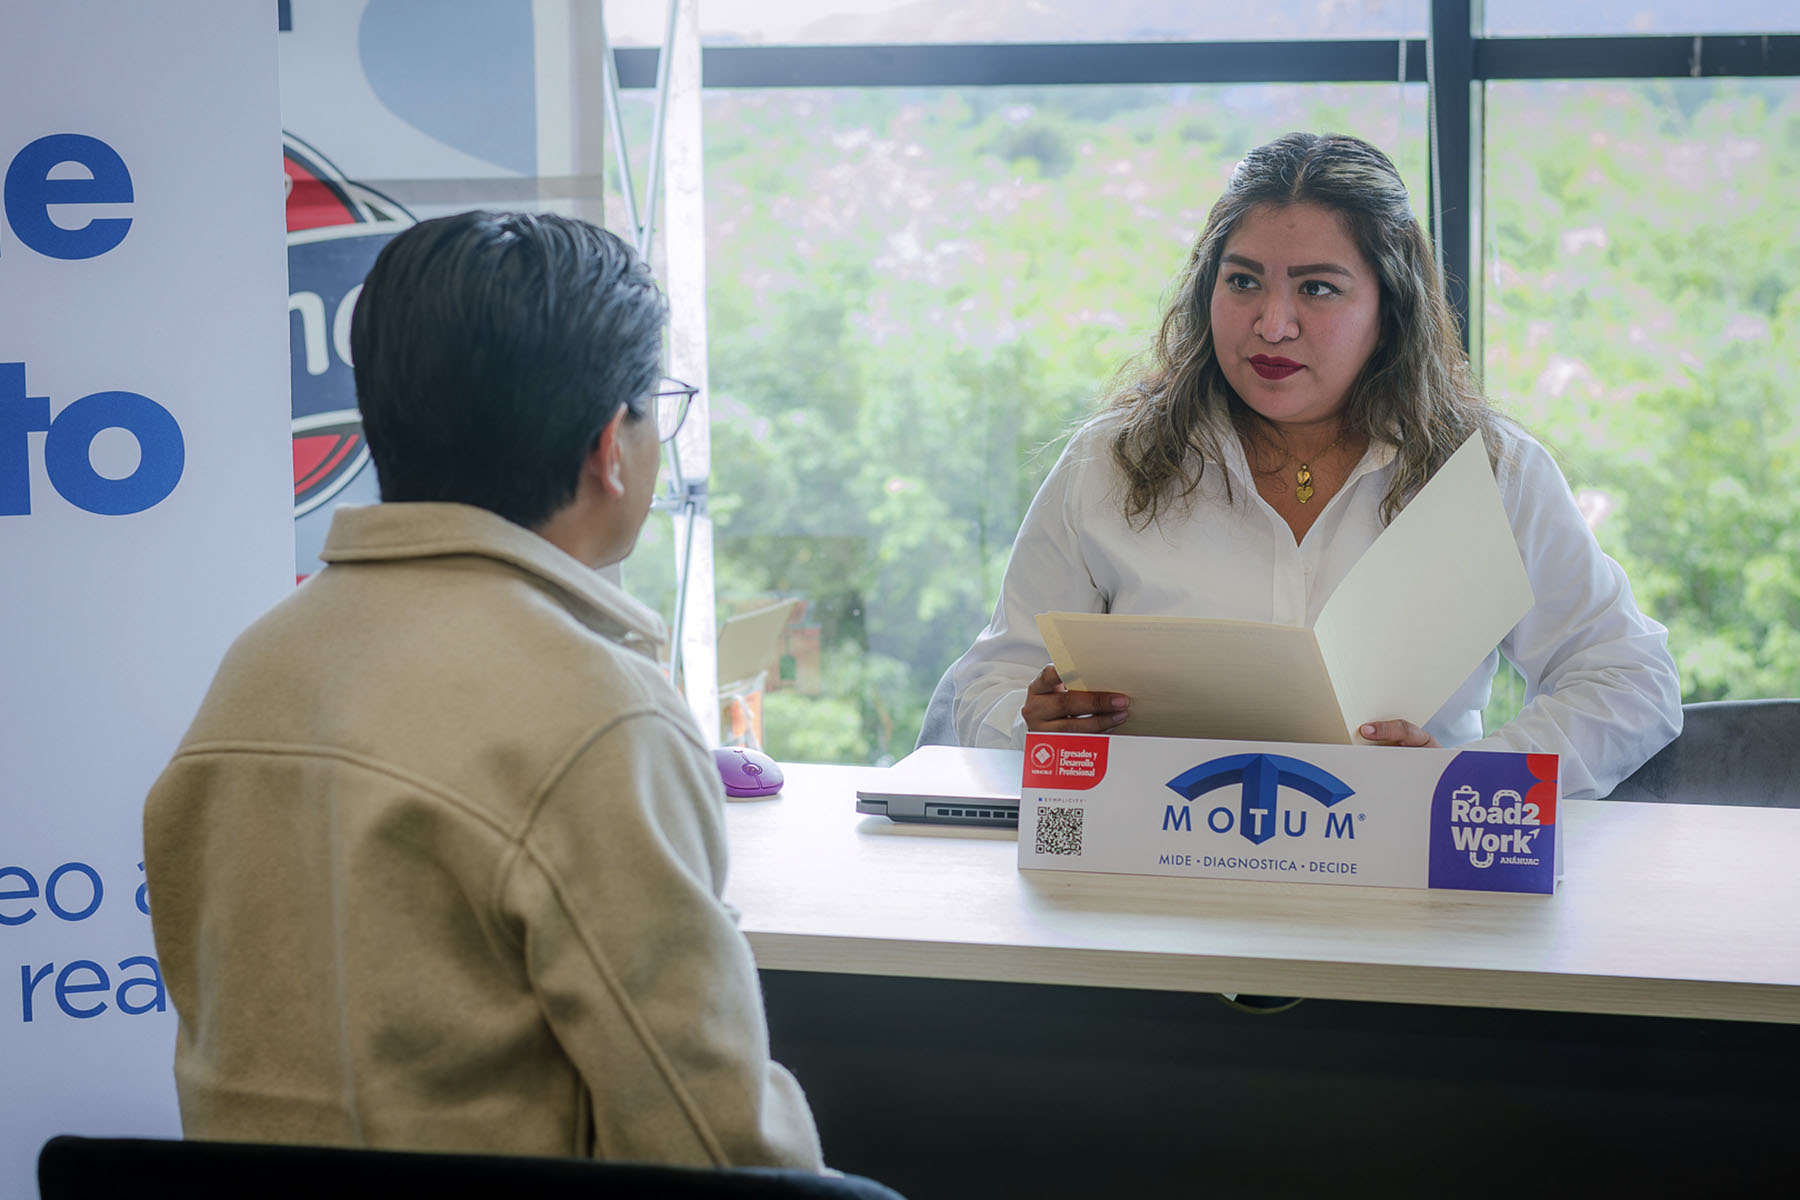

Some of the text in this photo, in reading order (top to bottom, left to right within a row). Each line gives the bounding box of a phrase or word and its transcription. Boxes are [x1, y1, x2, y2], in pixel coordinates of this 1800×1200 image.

[1059, 758, 1094, 767] Desarrollo
[1060, 748, 1098, 760] Egresados y
[1059, 768, 1095, 776] Profesional
[1450, 799, 1541, 826] Road2
[1450, 826, 1532, 854] Work
[1159, 854, 1358, 874] MIDE DIAGNOSTICA DECIDE
[0, 861, 104, 926] eo
